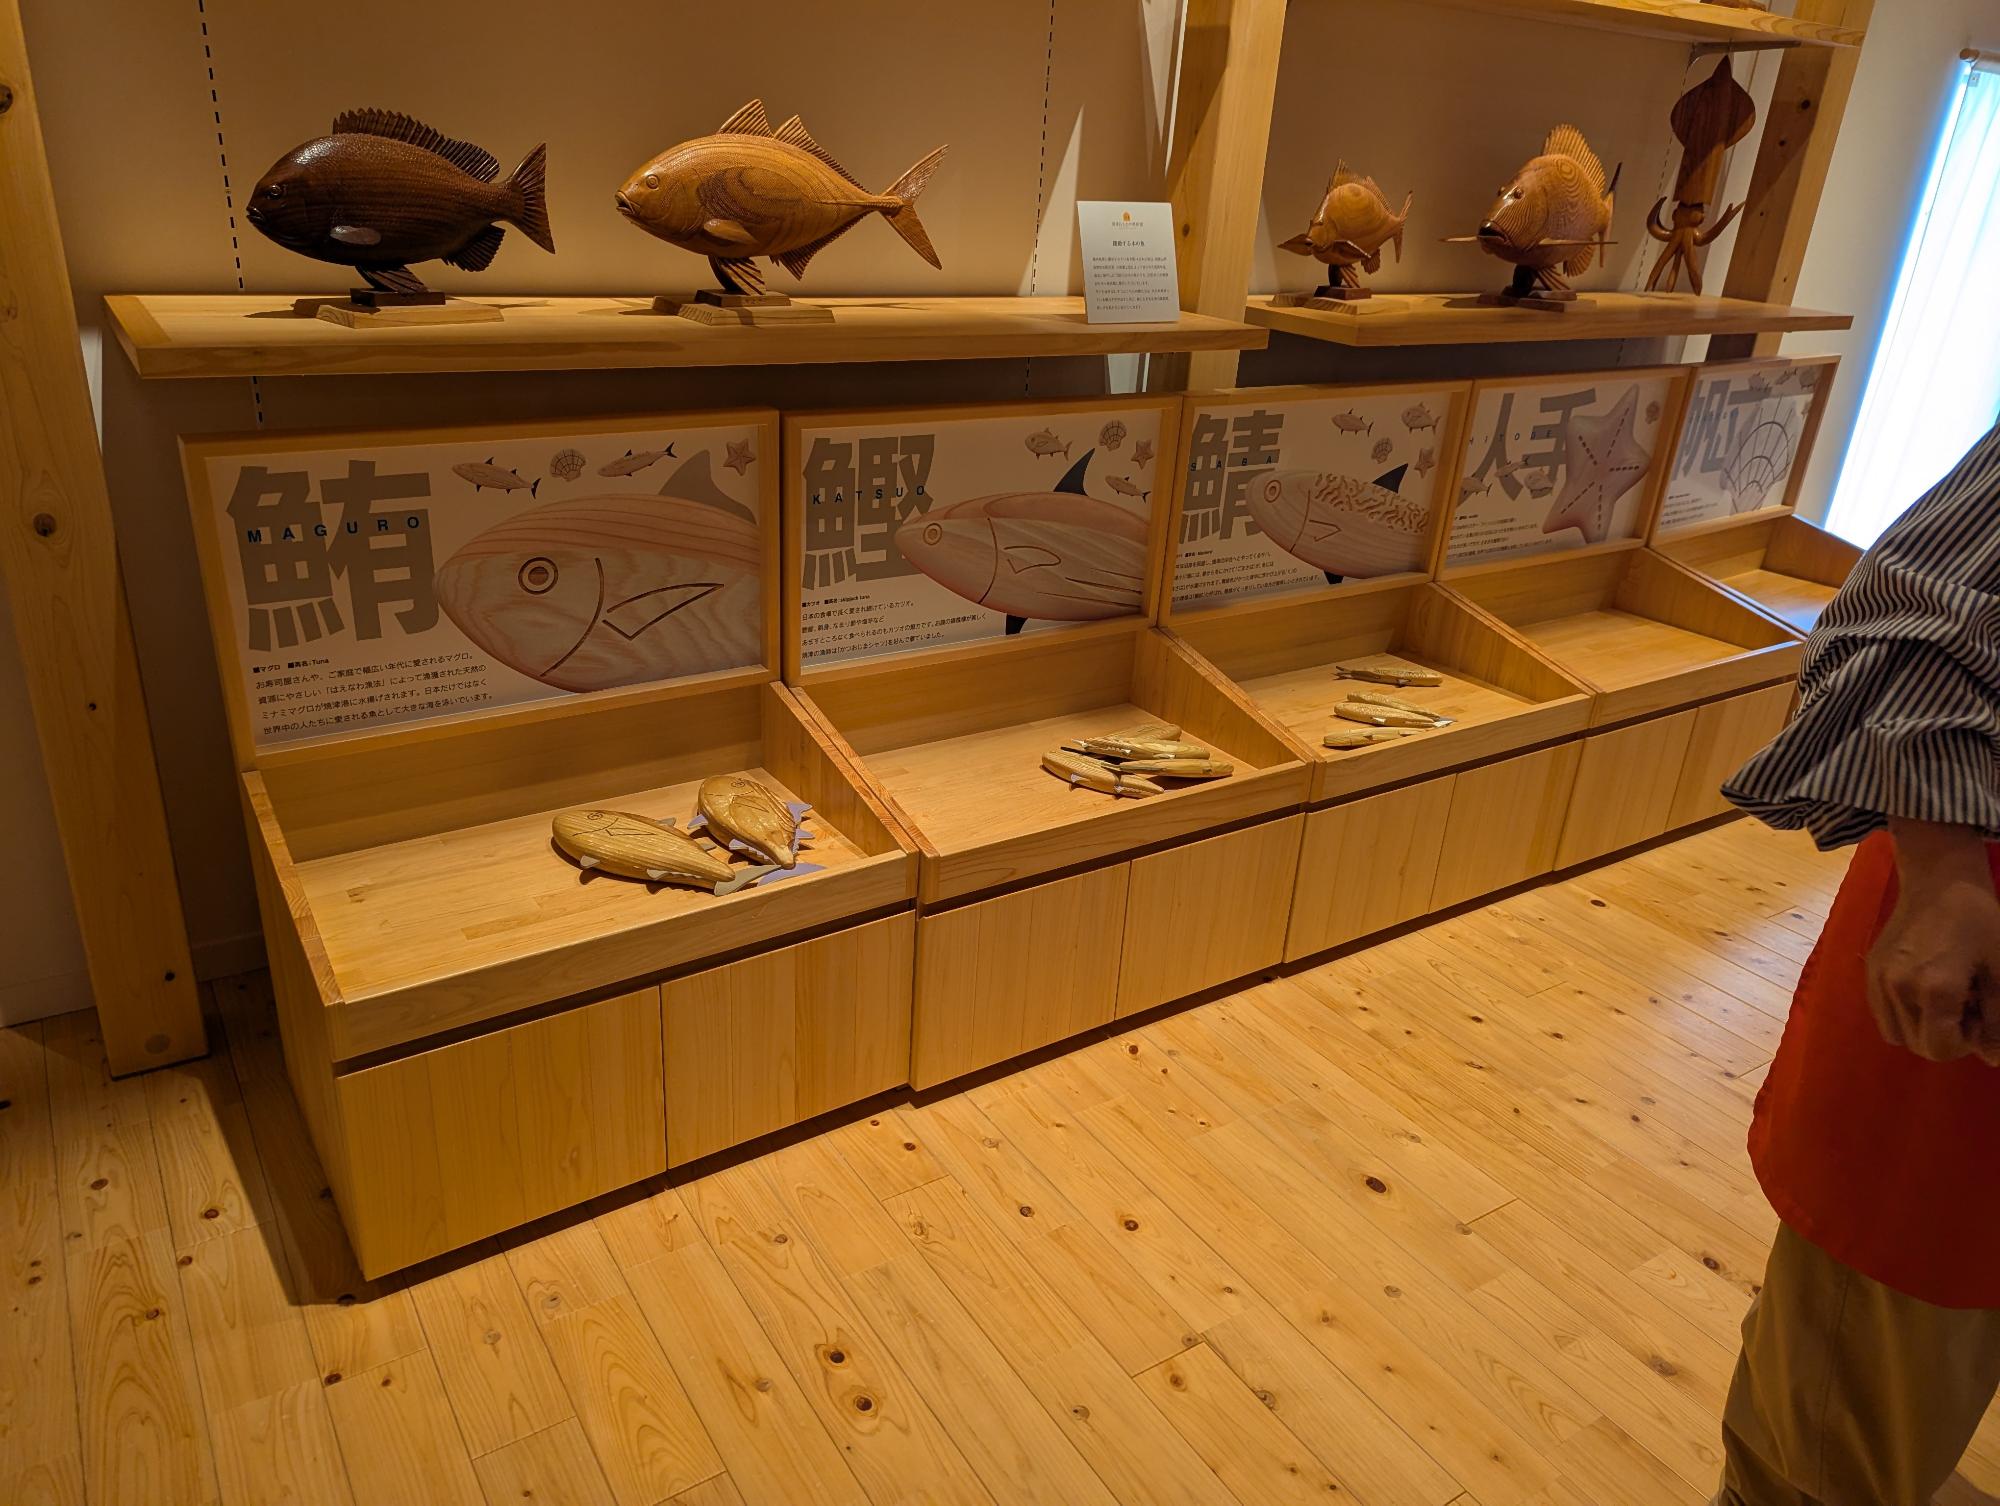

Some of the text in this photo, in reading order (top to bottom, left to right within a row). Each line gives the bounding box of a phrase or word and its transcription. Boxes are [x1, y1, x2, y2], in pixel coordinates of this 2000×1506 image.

[813, 485, 926, 505] KATSUO
[1179, 410, 1284, 544] 鯖
[1190, 455, 1272, 472] SABA
[248, 515, 420, 544] MAGURO
[802, 434, 935, 590] 鰹
[226, 460, 440, 652] 鮪
